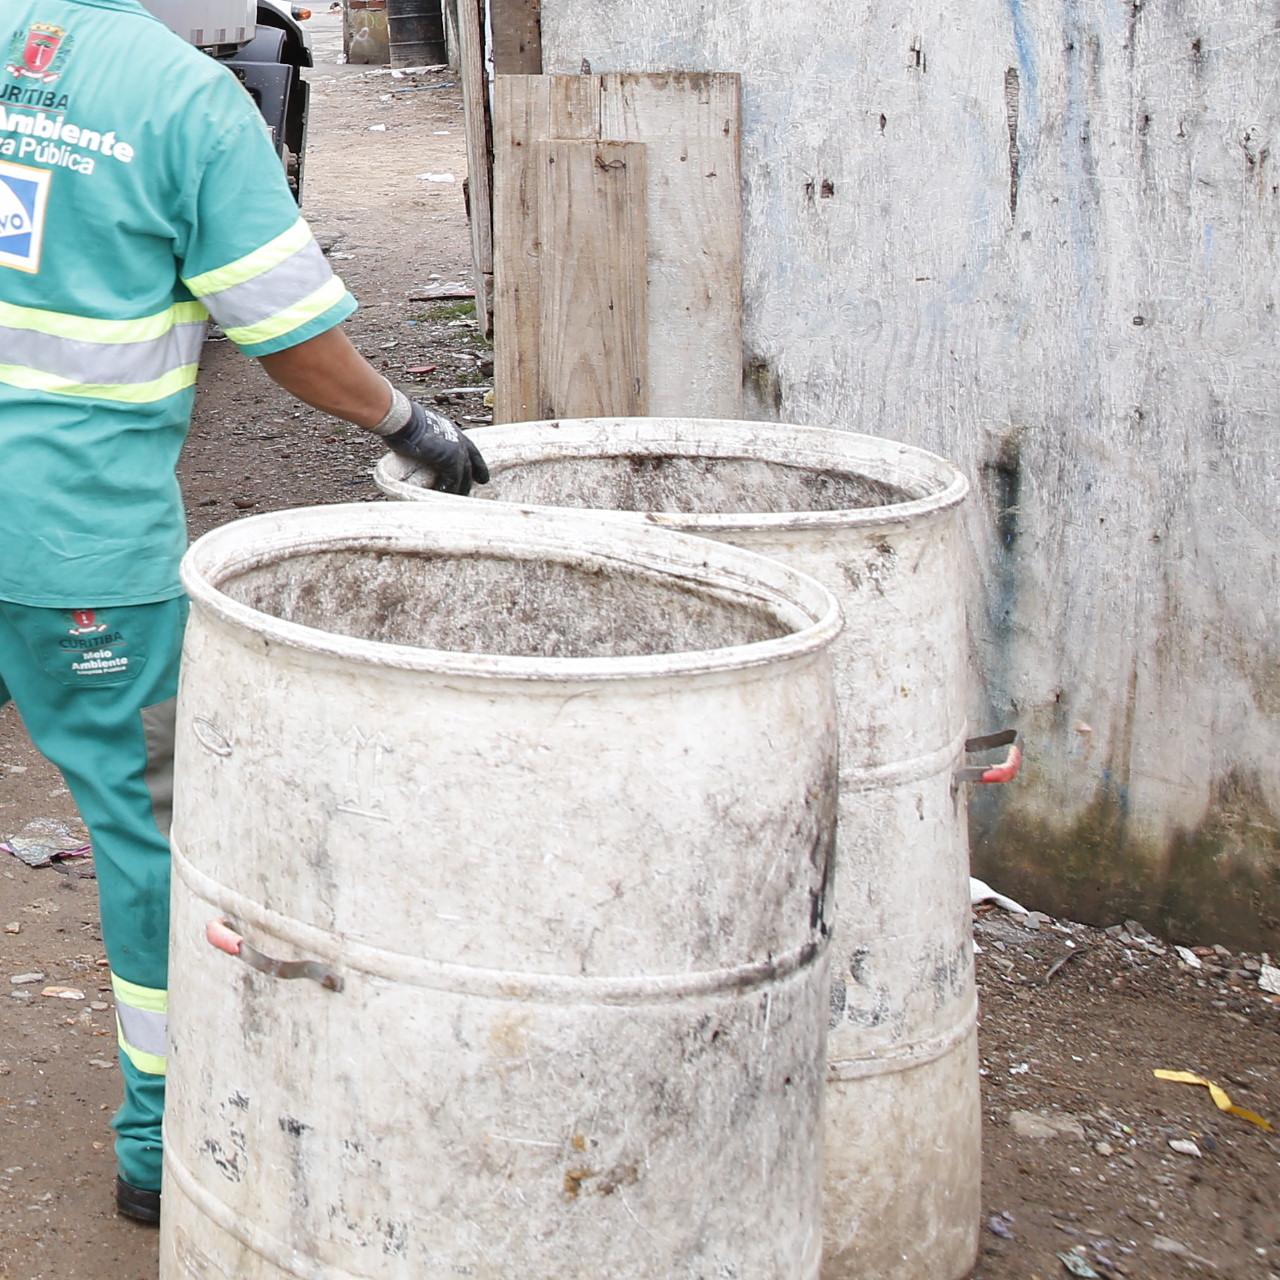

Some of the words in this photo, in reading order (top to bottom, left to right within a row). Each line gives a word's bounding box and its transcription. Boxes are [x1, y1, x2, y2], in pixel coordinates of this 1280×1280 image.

[18, 136, 96, 175] Pública
[58, 631, 124, 649] CURITIBA
[83, 649, 112, 660] Meio
[72, 657, 128, 670] Ambiente
